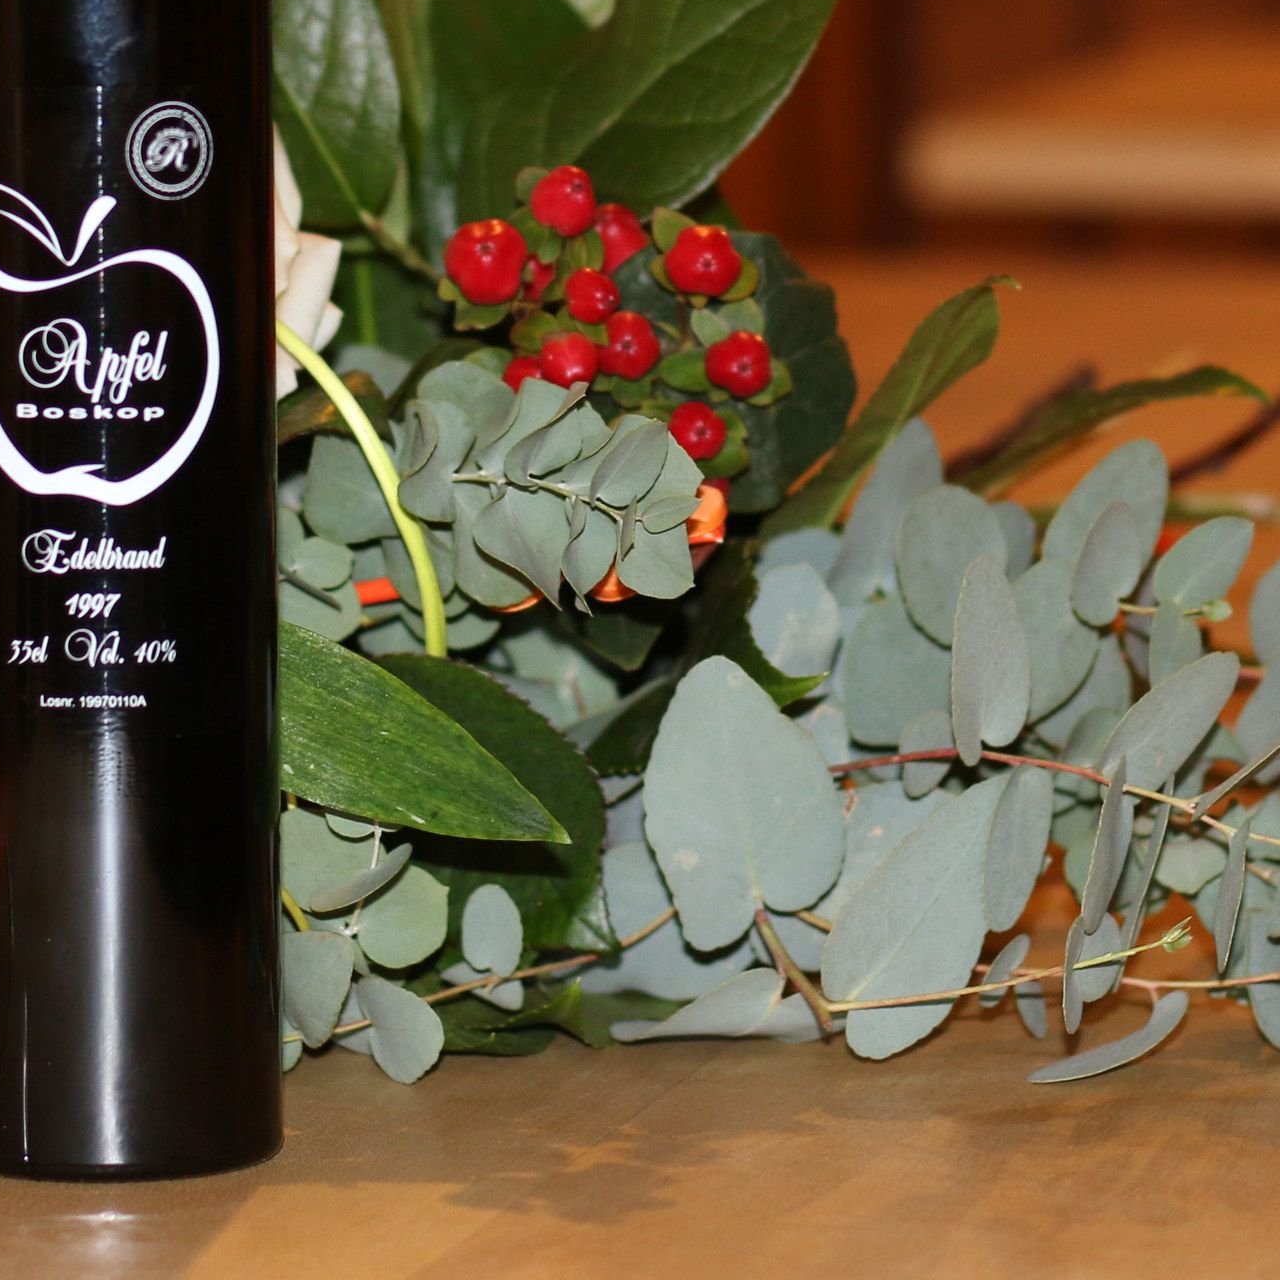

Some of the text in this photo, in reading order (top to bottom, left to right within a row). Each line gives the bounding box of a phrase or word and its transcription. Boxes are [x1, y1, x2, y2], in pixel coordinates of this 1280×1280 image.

[19, 317, 168, 404] Apfel
[15, 403, 165, 422] Boskop
[21, 529, 167, 574] Edelbrand
[64, 593, 121, 619] 1997
[64, 628, 125, 668] Vol.
[133, 640, 177, 664] 40%
[39, 694, 147, 708] Losnr. 19970110A
